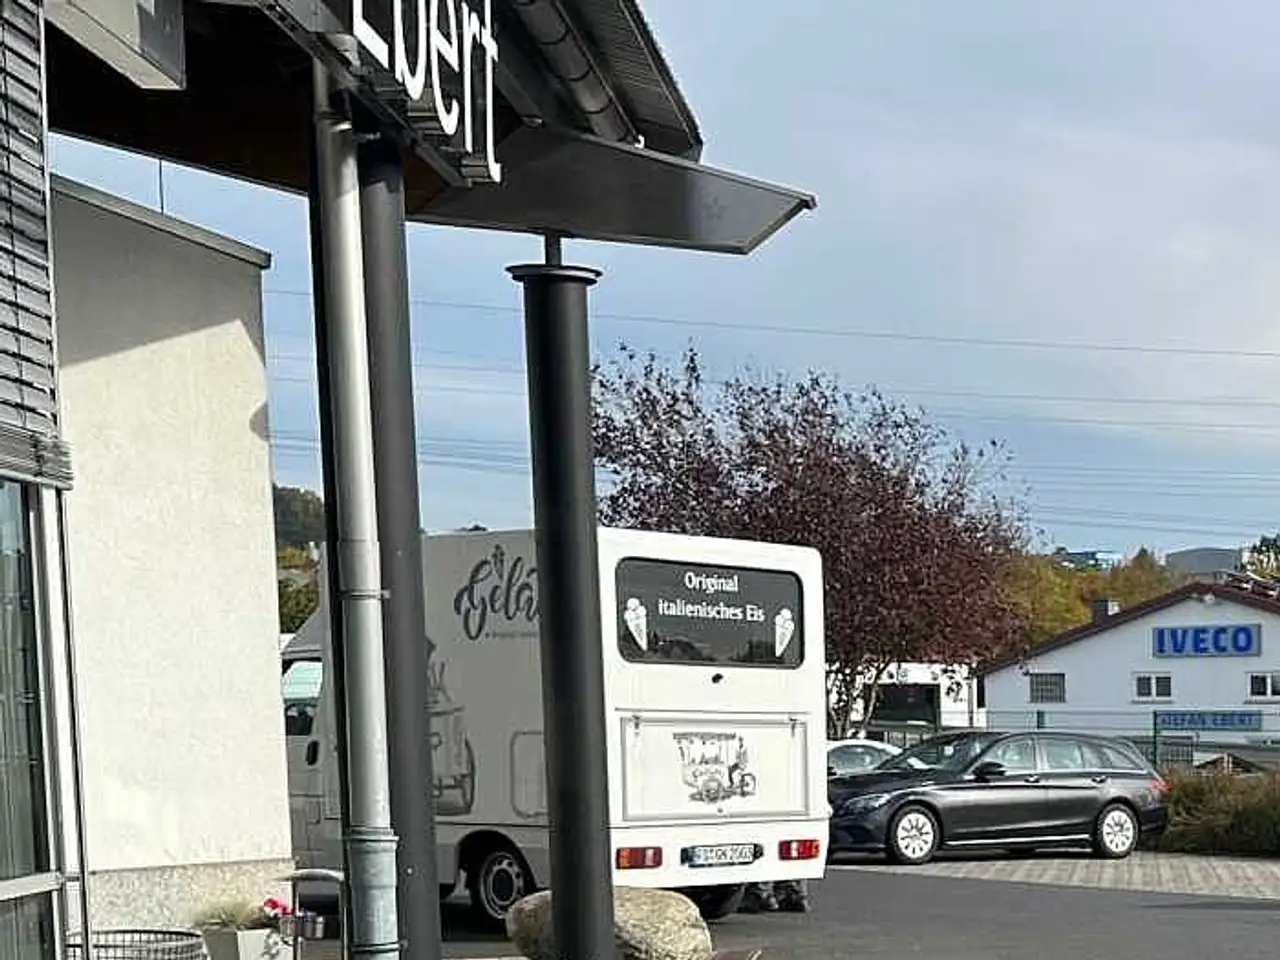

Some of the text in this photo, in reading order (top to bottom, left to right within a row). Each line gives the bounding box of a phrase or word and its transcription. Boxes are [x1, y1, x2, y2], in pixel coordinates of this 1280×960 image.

[352, 0, 502, 183] ert
[683, 571, 739, 594] Original
[453, 556, 541, 641] Gela
[658, 599, 766, 622] italienisches Eis
[1156, 626, 1253, 654] IVECO
